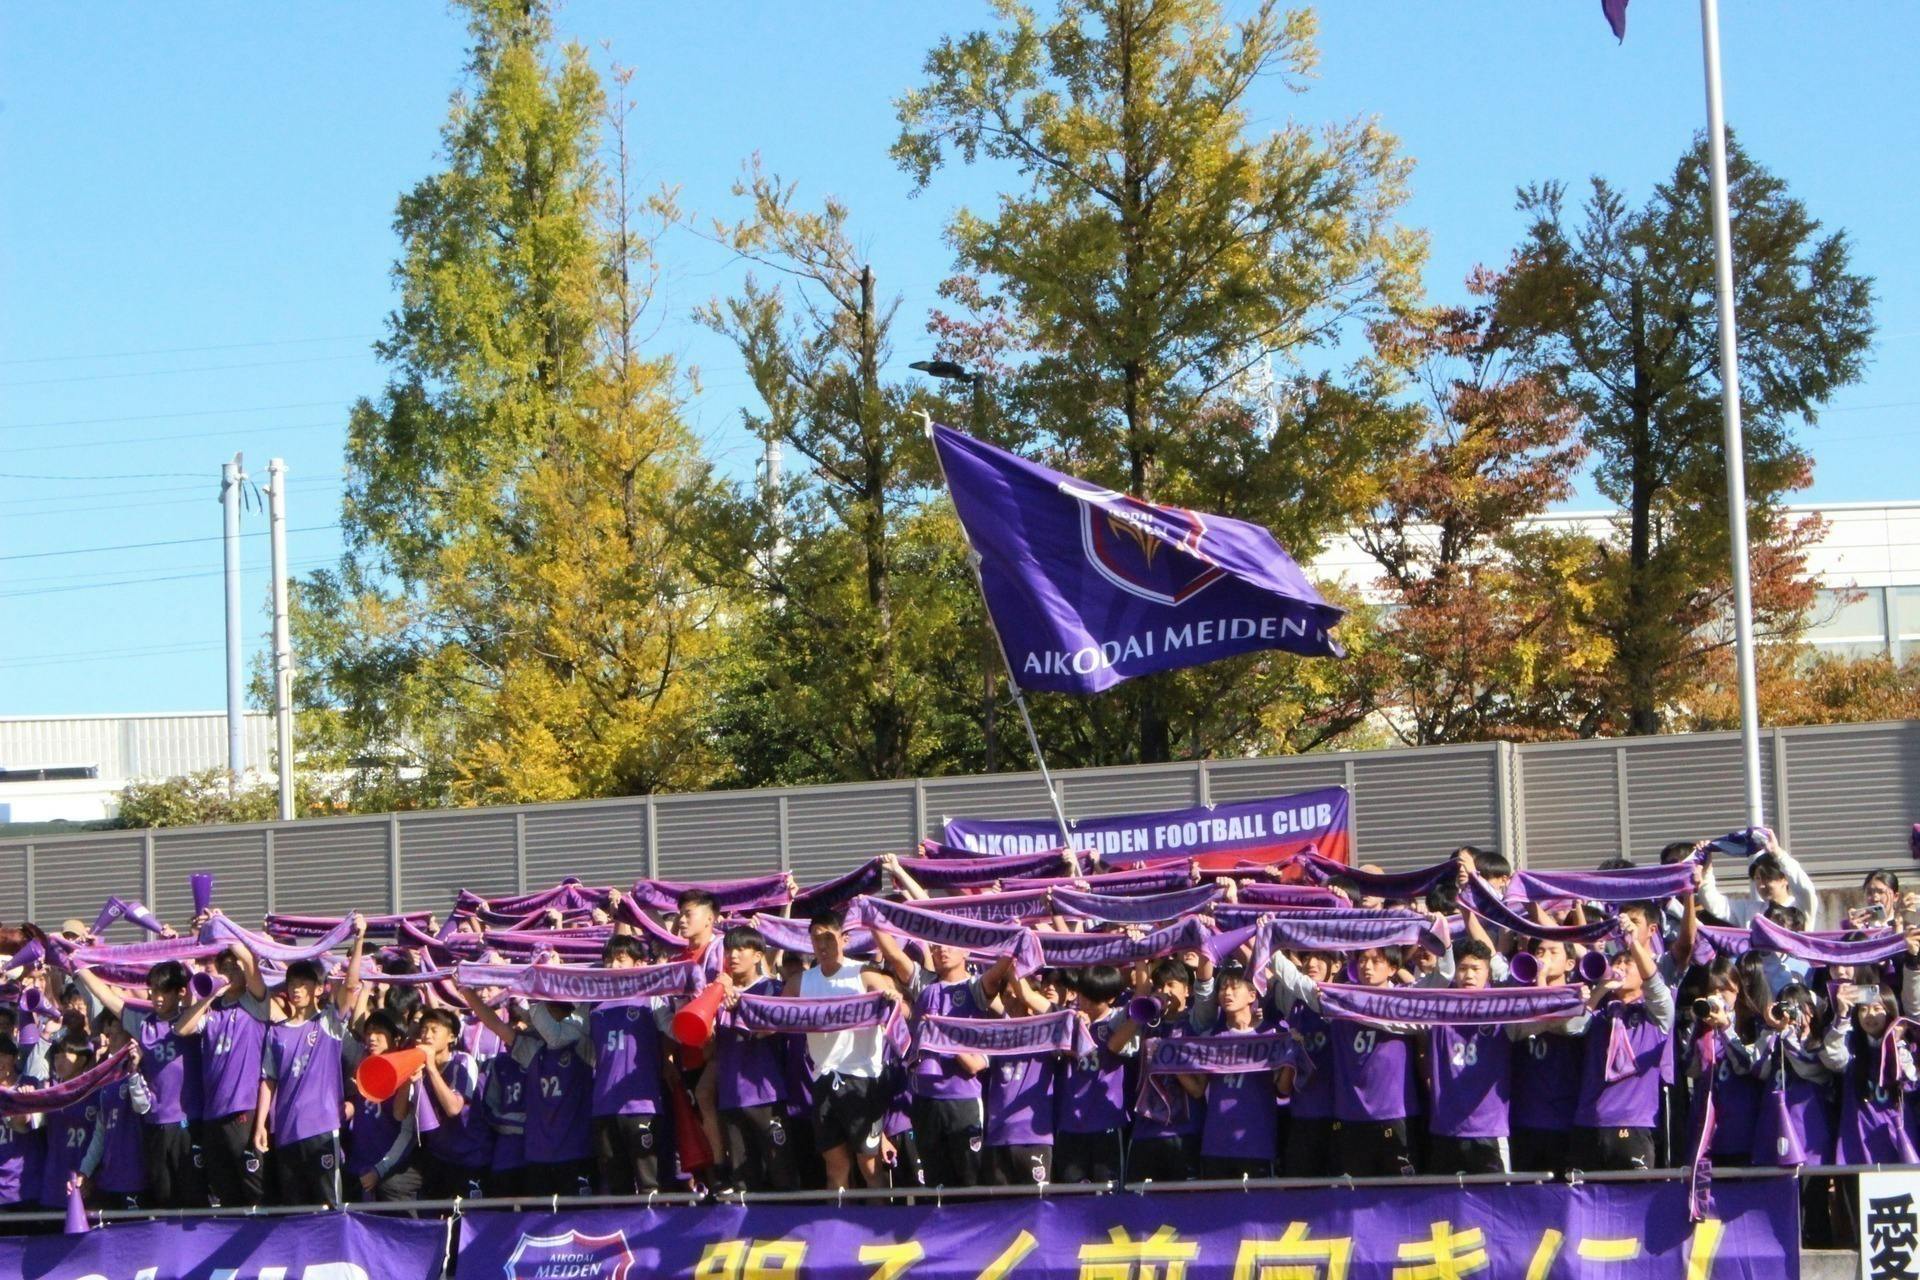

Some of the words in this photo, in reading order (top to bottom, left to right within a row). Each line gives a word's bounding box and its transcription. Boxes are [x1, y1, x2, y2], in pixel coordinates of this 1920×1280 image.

[1024, 630, 1154, 675] AIKODAI
[1164, 617, 1308, 653] MEIDEN
[964, 833, 1057, 856] AIKODAI
[1067, 828, 1144, 856] MEIDEN
[1155, 813, 1267, 848] FOOTBALL
[1273, 803, 1332, 836] CLUB
[1360, 996, 1451, 1019] AIKODAI
[1453, 995, 1541, 1019] MEIDEN
[1353, 1029, 1377, 1055] 67
[66, 1127, 86, 1149] 29
[549, 1253, 594, 1263] AIKODAI
[535, 1262, 602, 1279] MEIDEN
